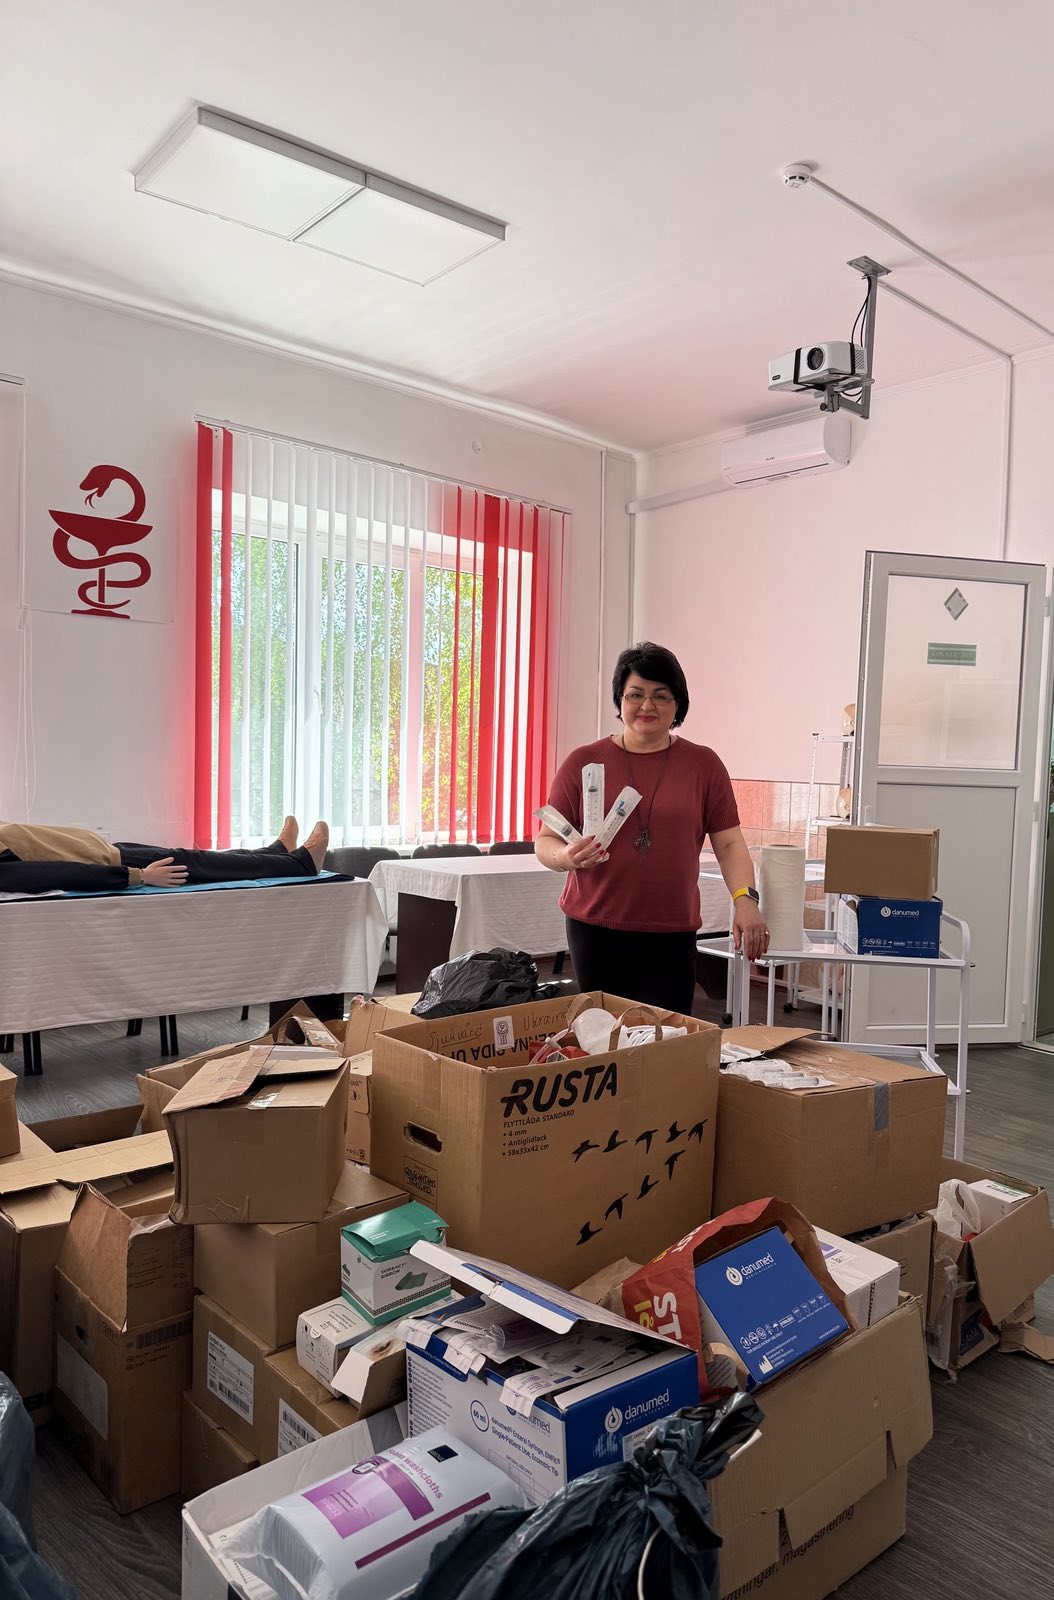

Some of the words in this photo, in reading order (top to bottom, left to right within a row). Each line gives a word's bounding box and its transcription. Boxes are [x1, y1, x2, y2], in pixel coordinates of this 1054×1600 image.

[891, 909, 920, 917] danumed
[500, 1062, 617, 1118] RUSTA
[503, 1116, 541, 1129] FLYTTLÅDA
[542, 1109, 575, 1122] STANDARD
[507, 1134, 548, 1147] Antiglidlack
[507, 1144, 539, 1157] 58x33x42
[540, 1143, 550, 1151] cm
[740, 1251, 775, 1276] danumed
[624, 1387, 670, 1420] danumed
[404, 1458, 443, 1499] washcloths
